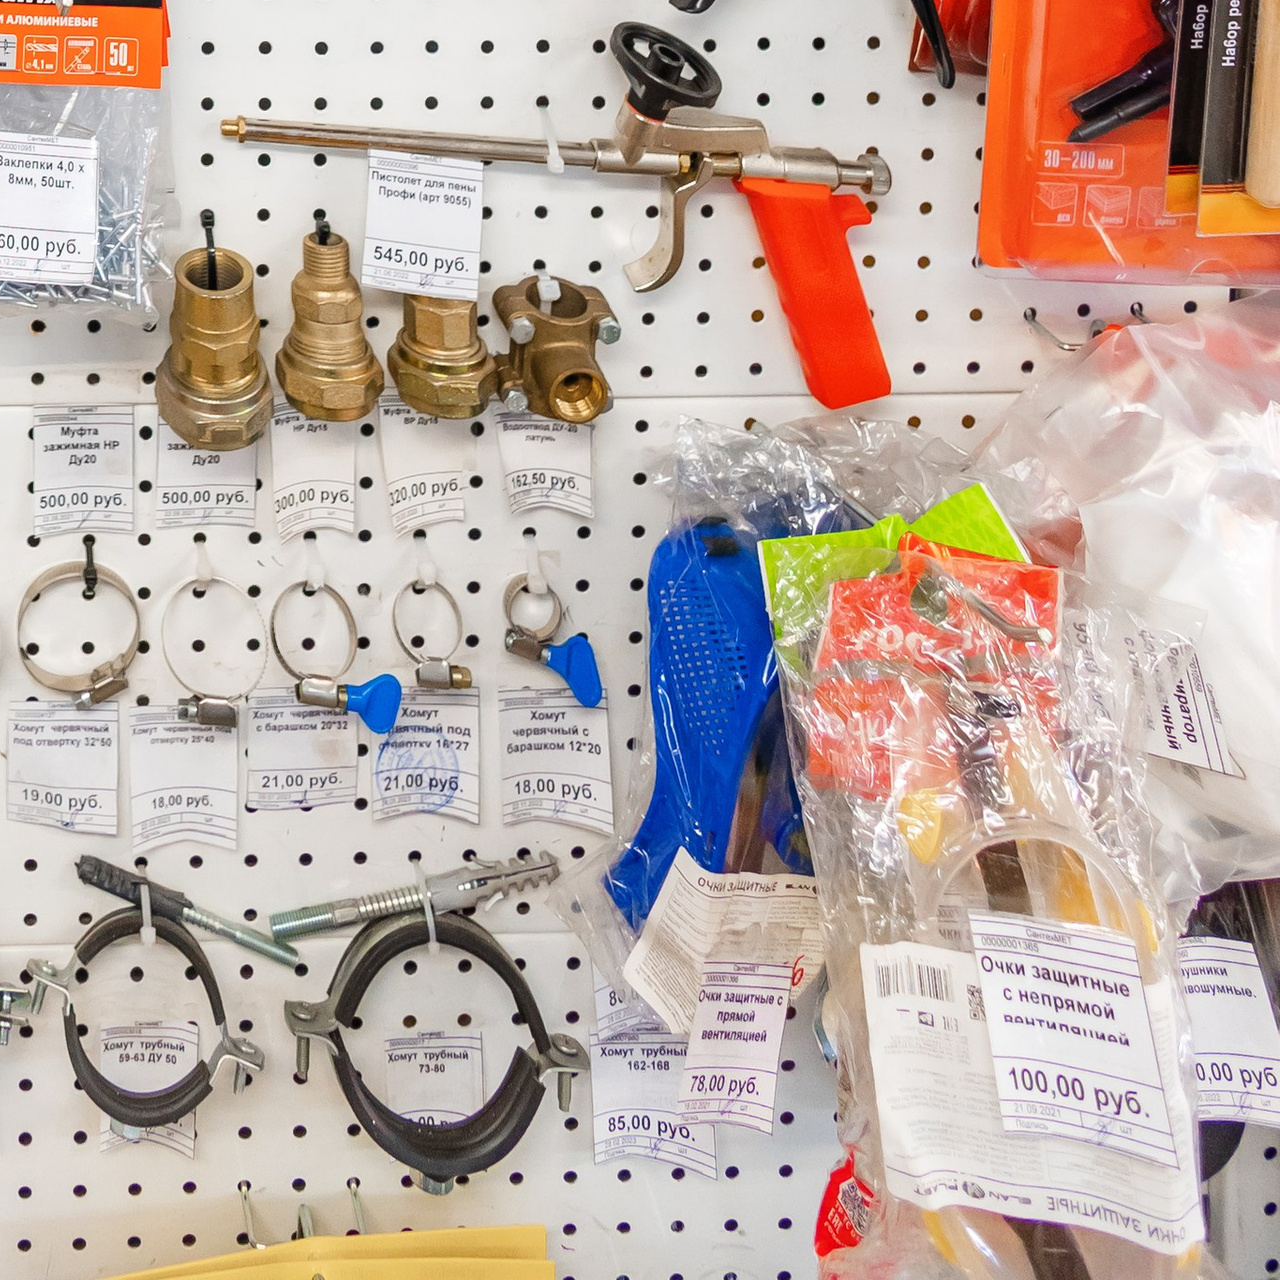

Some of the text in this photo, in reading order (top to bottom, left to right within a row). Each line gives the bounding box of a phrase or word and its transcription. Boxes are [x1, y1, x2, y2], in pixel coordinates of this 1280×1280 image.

[7, 13, 98, 28] АЛЮМИНИЕВЫЕ
[378, 186, 416, 203] Профи
[45, 238, 82, 257] руб.
[373, 246, 470, 273] 545,00 руб.
[514, 778, 597, 802] 18,00 руб.
[981, 954, 1130, 999] Очки защитные
[1008, 1065, 1150, 1119] 100,00 руб.
